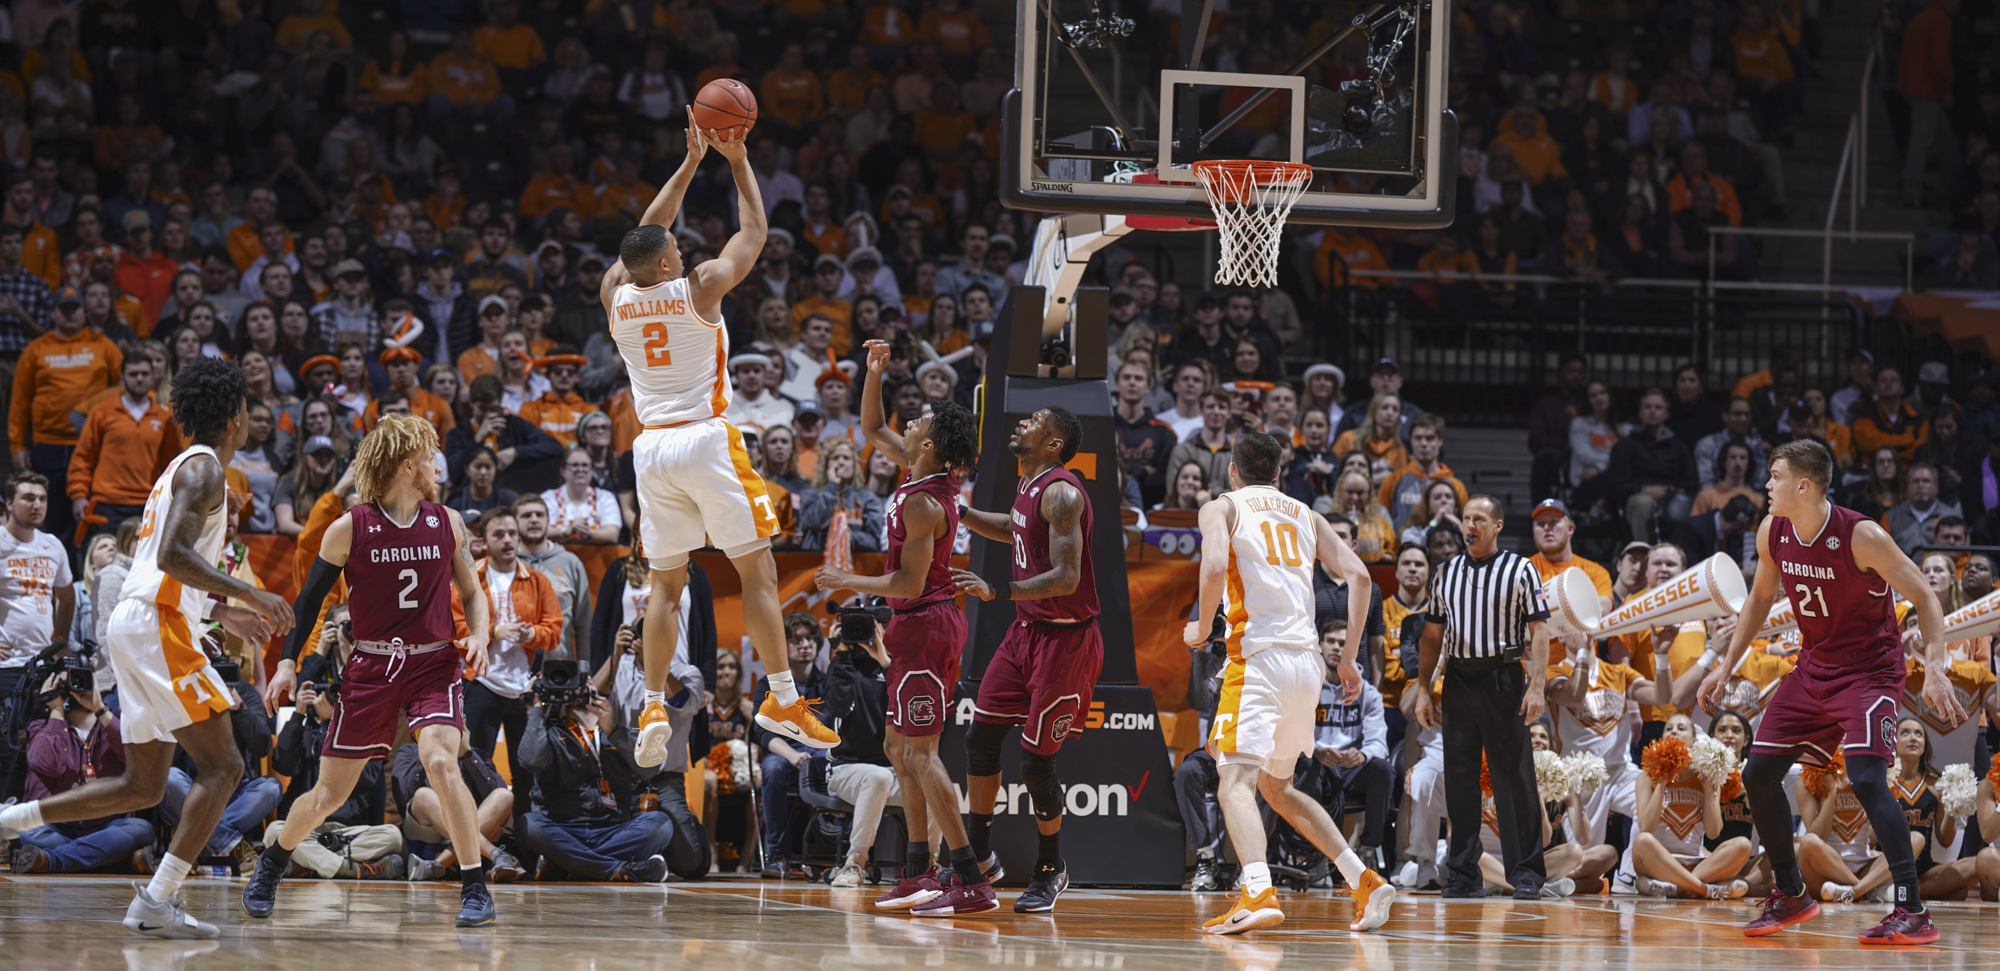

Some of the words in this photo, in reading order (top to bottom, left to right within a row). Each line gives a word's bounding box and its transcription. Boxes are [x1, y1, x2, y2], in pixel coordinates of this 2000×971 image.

[1031, 182, 1073, 193] SPALDING
[616, 300, 685, 321] WILLIAMS
[642, 322, 672, 367] 2
[754, 494, 776, 521] T
[1245, 496, 1301, 519] FULKERSON
[370, 545, 441, 563] CAROLINA
[1260, 521, 1302, 567] 10
[1826, 536, 1840, 550] SEC
[8, 558, 28, 568] ONE
[1781, 560, 1835, 580] CAROLINA
[398, 568, 418, 609] 2
[1599, 572, 1700, 630] TENNESSEE
[1795, 583, 1830, 618] 21
[178, 672, 212, 704] T
[1214, 713, 1233, 739] T
